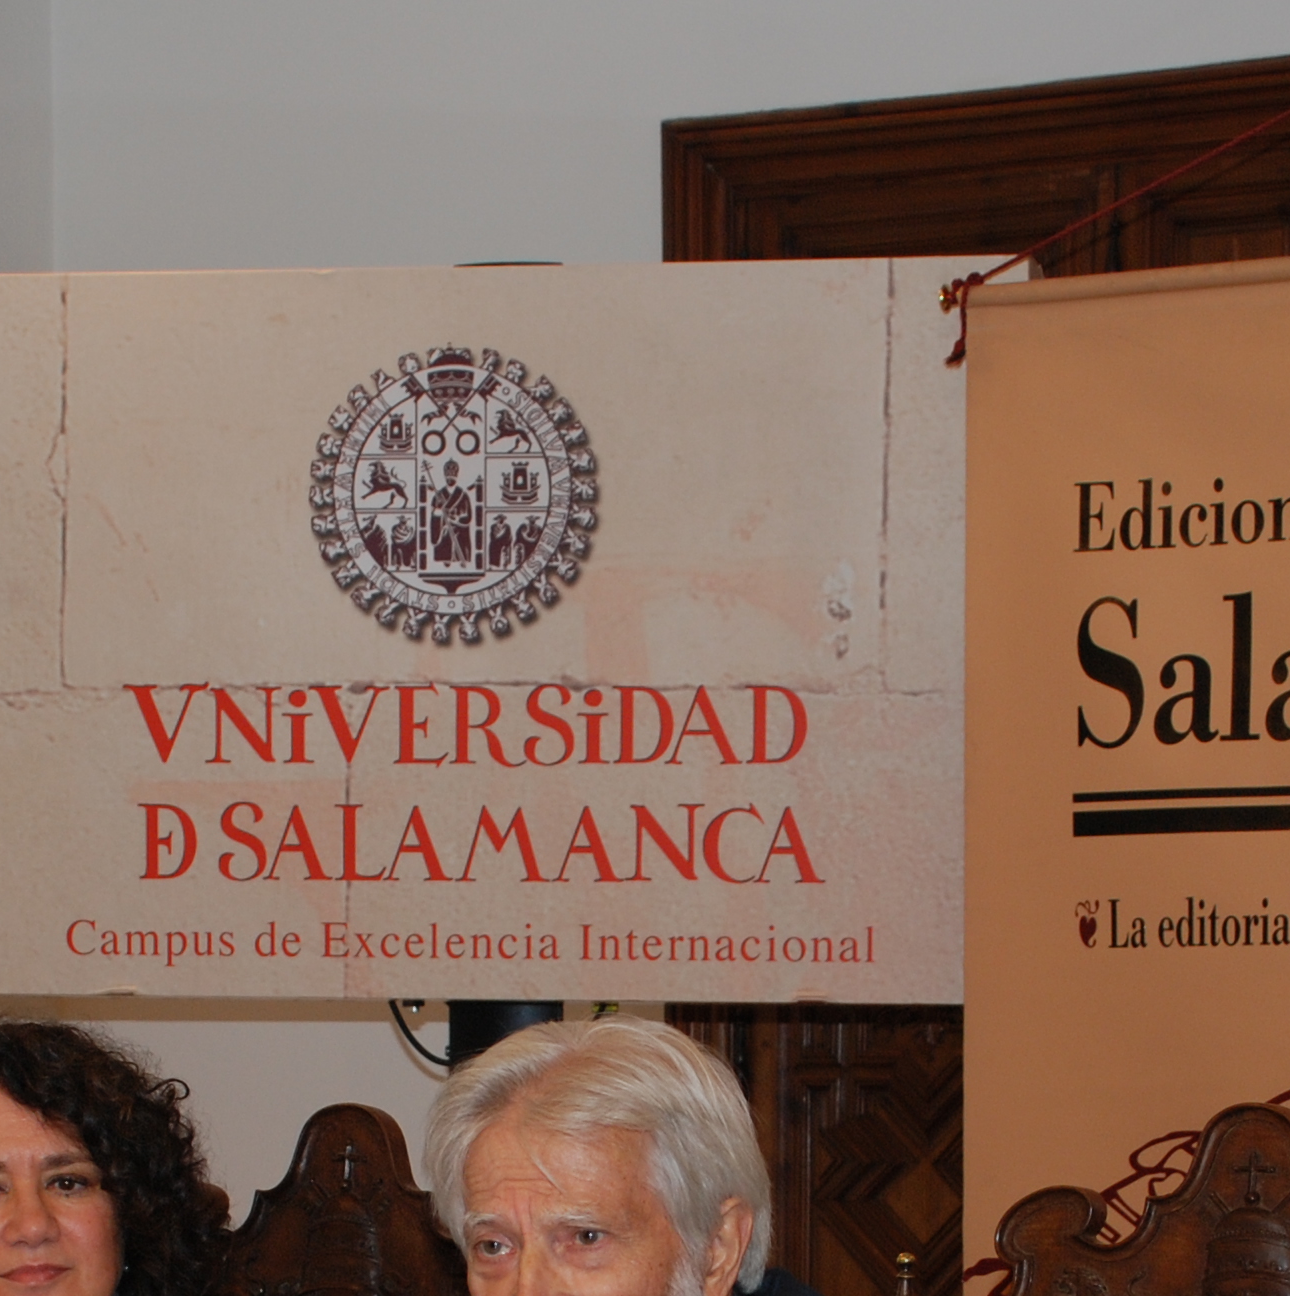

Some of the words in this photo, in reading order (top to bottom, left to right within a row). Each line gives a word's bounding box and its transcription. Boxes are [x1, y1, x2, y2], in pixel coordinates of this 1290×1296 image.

[218, 801, 824, 885] SALAMANCA
[66, 920, 236, 967] Campus
[255, 922, 302, 958] de
[323, 922, 560, 961] Excelencia
[581, 924, 876, 964] Internacional
[1108, 899, 1147, 949] La
